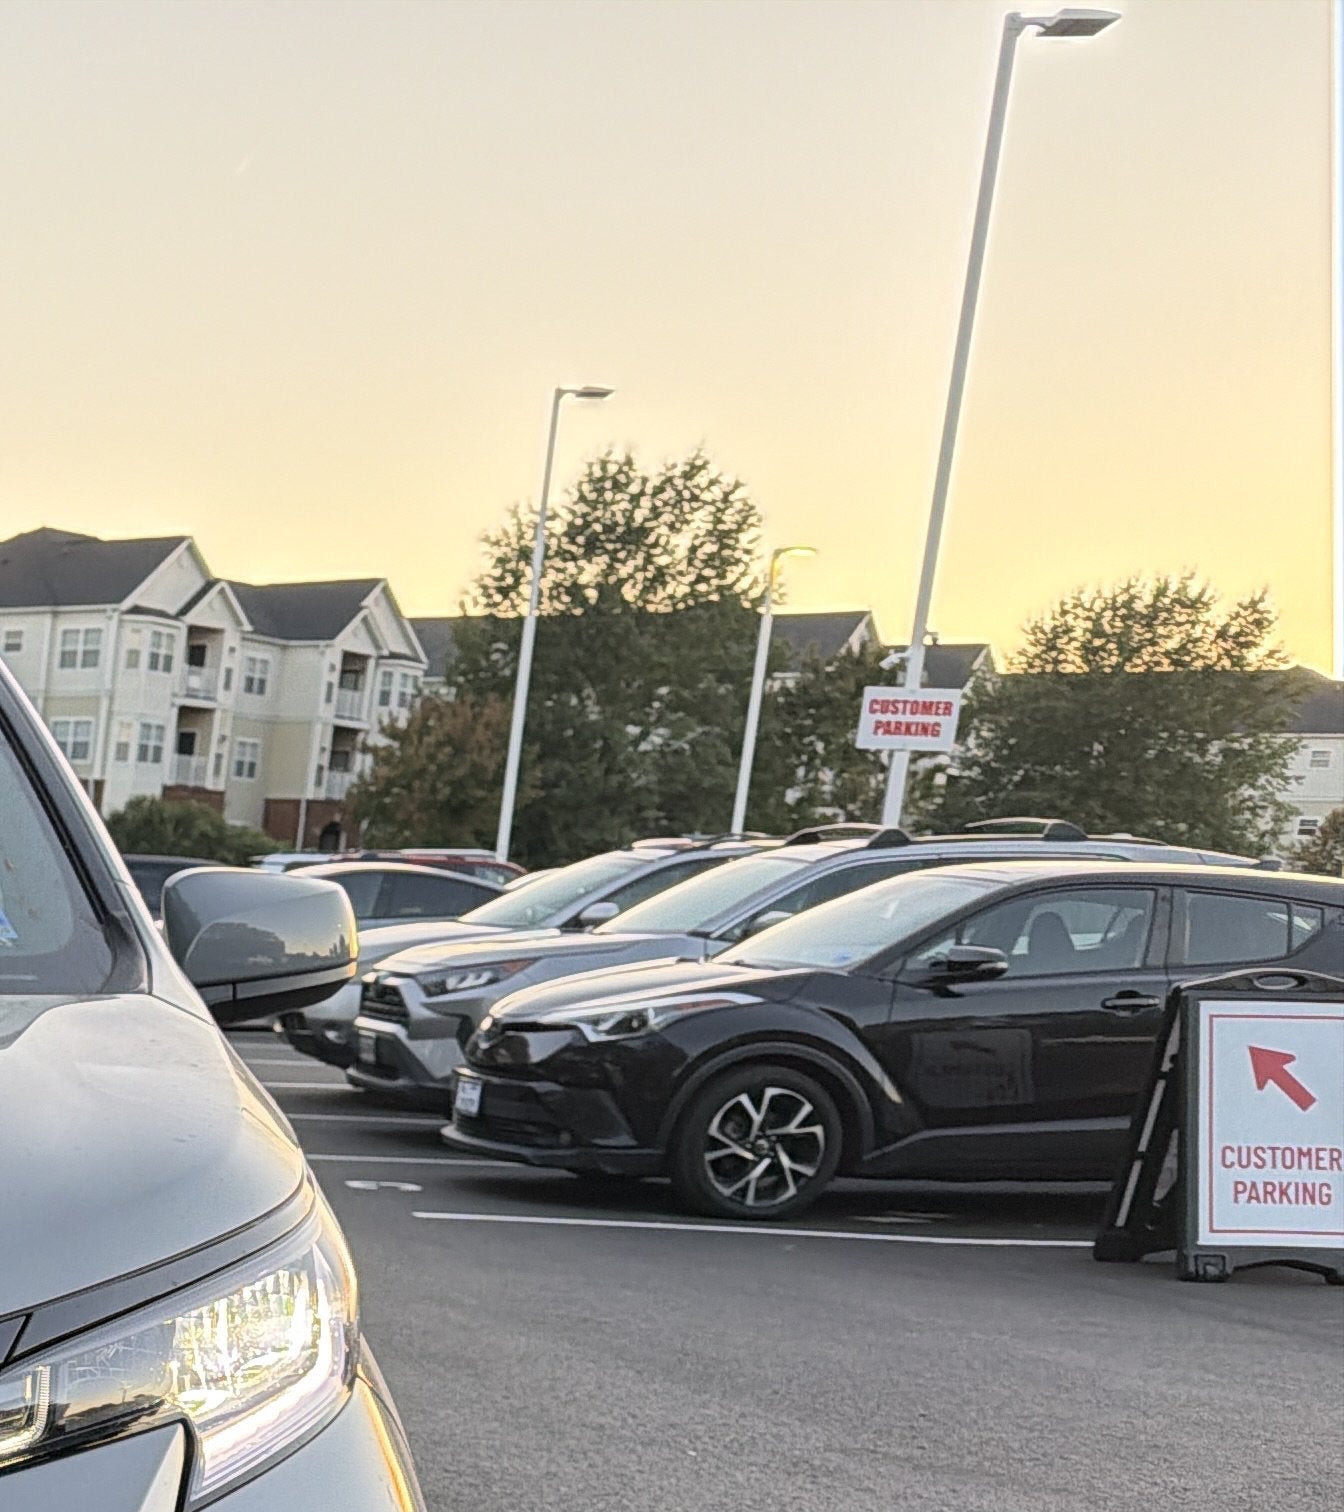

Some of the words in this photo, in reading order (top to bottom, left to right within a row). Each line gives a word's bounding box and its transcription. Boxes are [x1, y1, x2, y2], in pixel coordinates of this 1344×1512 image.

[869, 699, 953, 716] CUSTOMER
[873, 720, 942, 737] PARKING
[1221, 1145, 1343, 1170] CUSTOMER
[1233, 1181, 1332, 1205] PARKING
